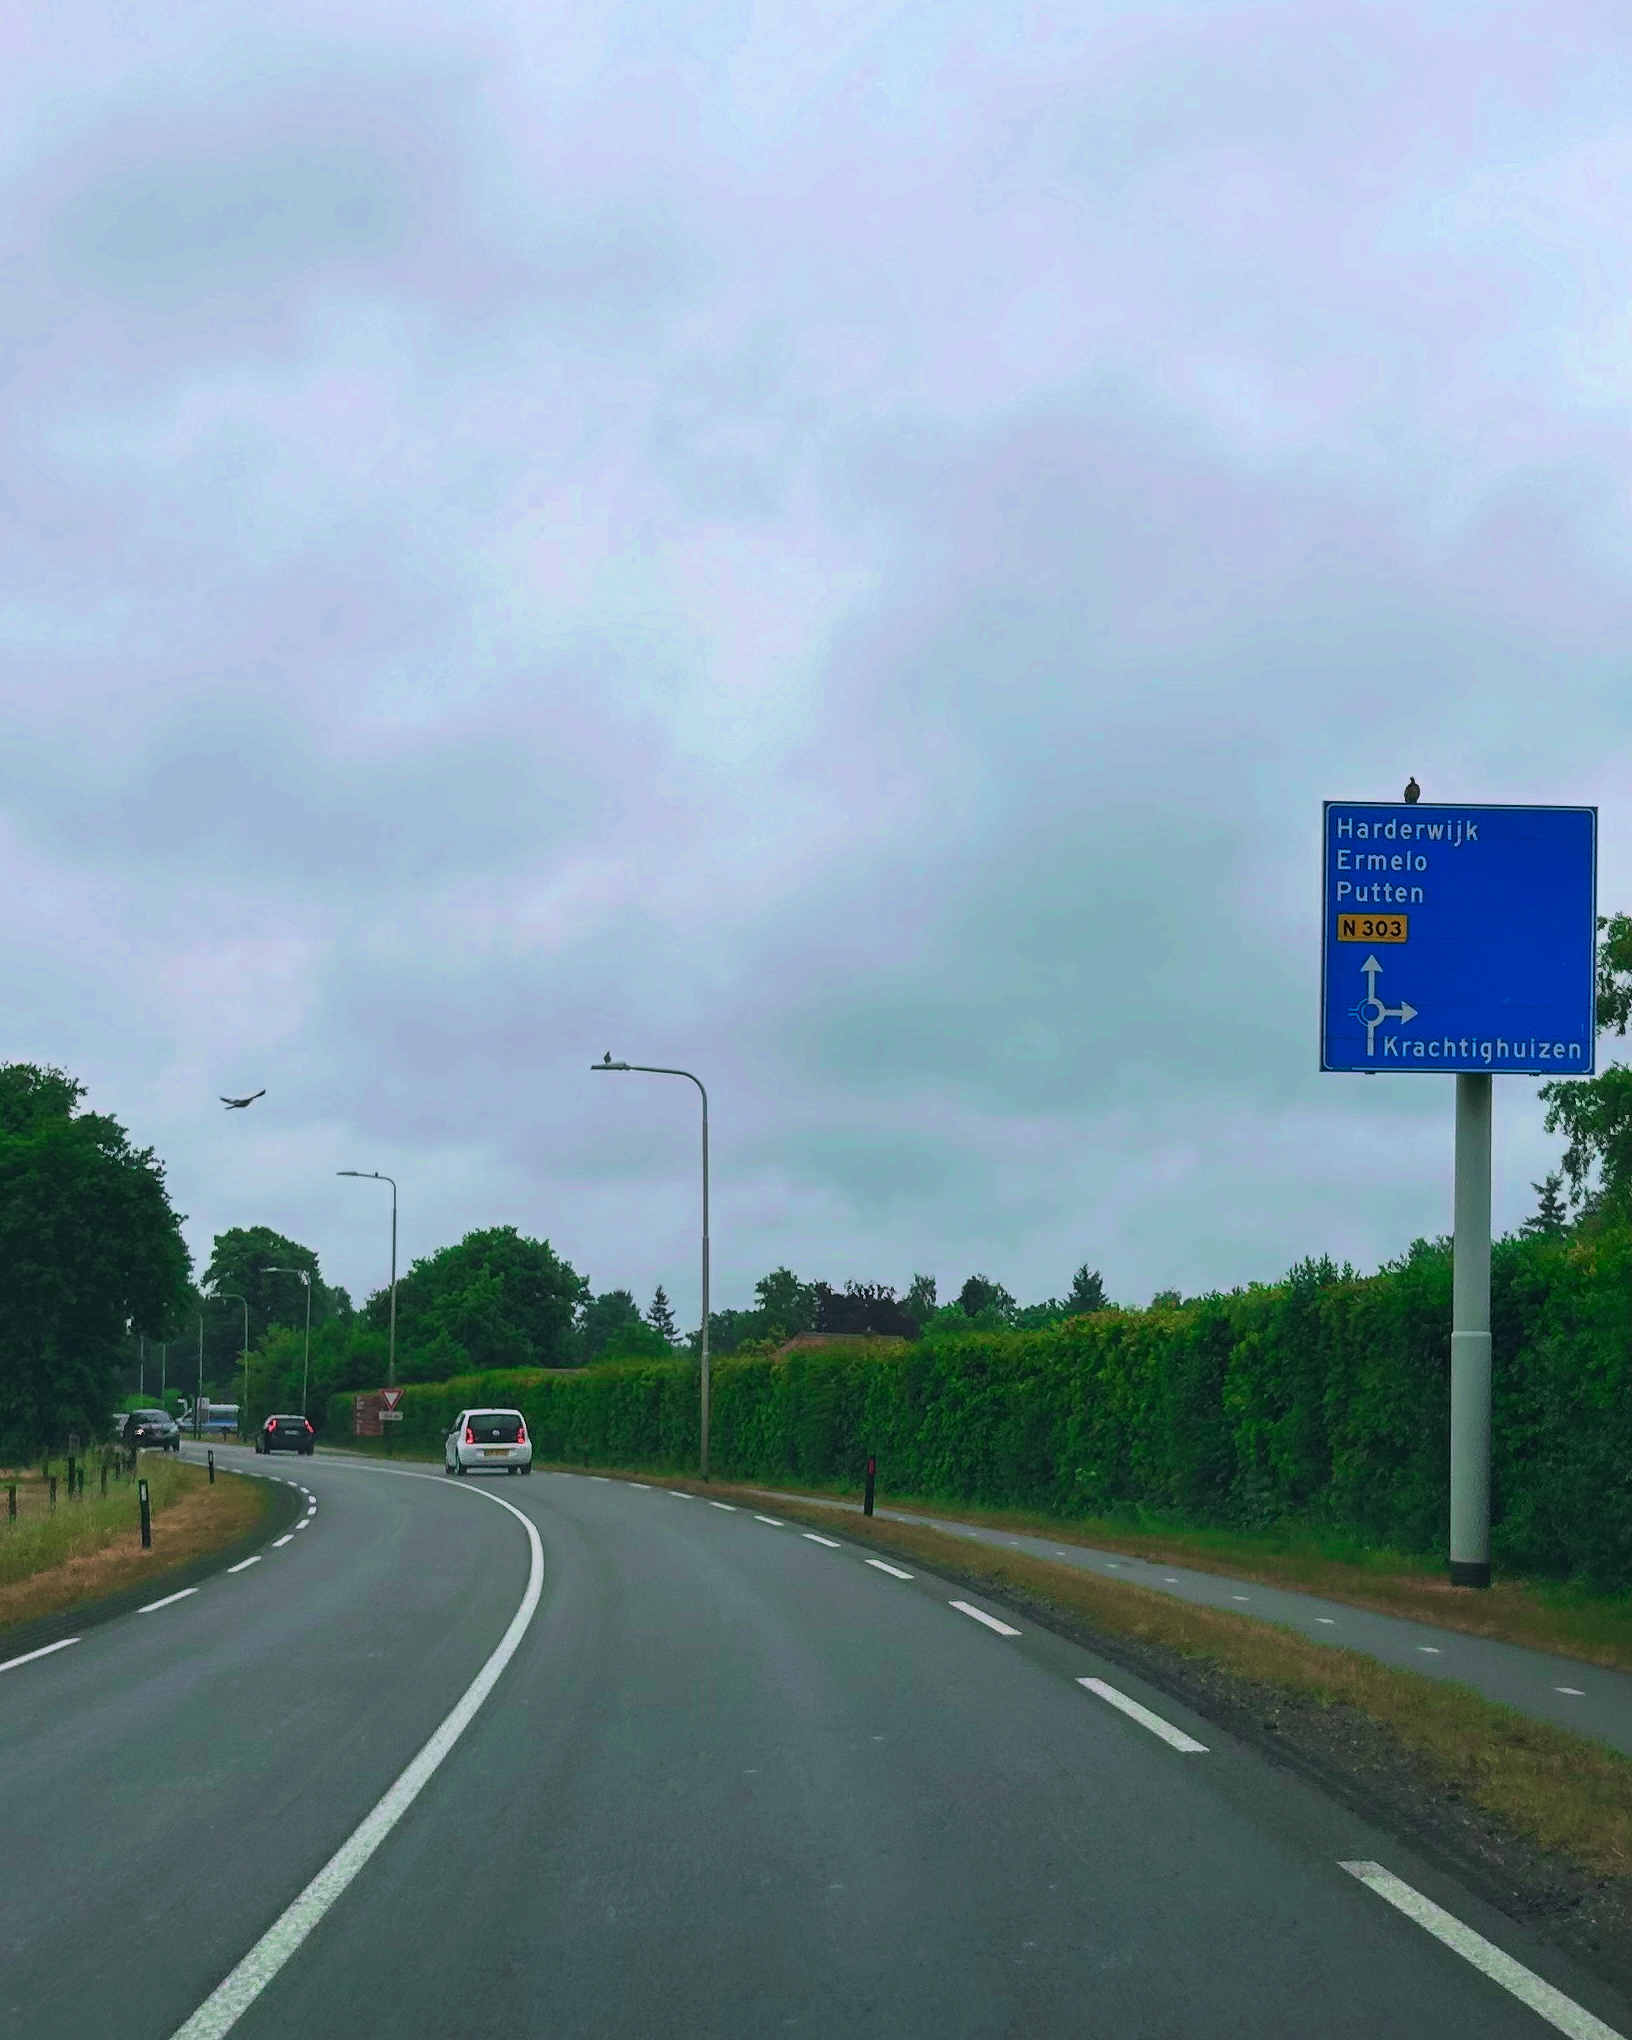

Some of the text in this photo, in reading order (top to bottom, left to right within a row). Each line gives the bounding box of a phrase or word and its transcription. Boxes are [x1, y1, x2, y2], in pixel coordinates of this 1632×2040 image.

[1337, 817, 1479, 847] Harderwijk
[1337, 849, 1428, 872] Ermelo
[1337, 881, 1425, 904] Putten
[1343, 919, 1403, 938] N 303
[1383, 1036, 1582, 1064] Krachtighuizen
